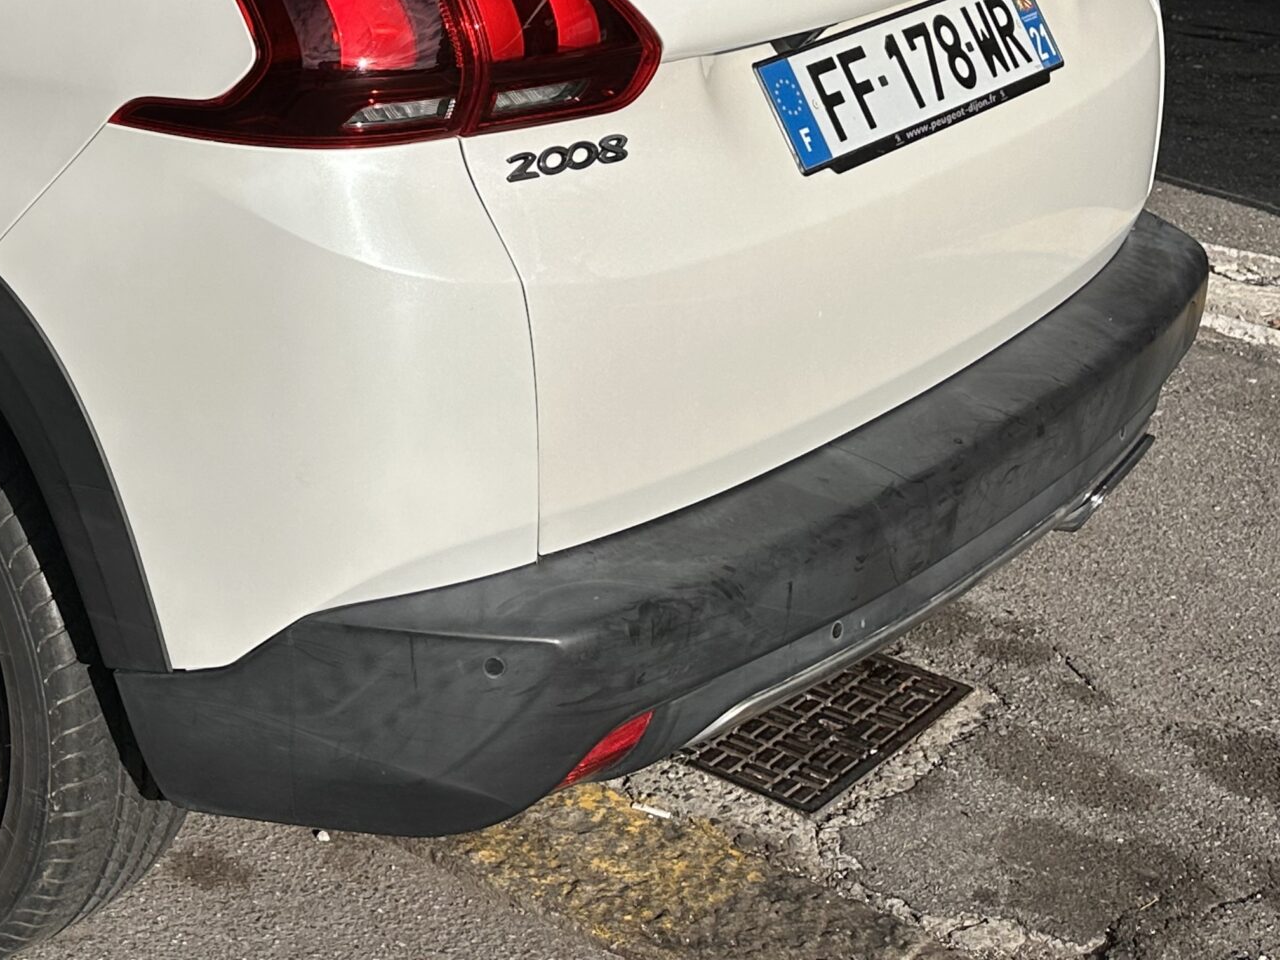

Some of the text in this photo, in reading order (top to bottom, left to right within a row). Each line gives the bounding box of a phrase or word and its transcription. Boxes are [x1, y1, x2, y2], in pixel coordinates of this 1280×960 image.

[799, 126, 813, 152] F
[1028, 23, 1057, 61] 21
[905, 93, 998, 140] www.peugeot-dijon.fr
[506, 133, 629, 183] 2008
